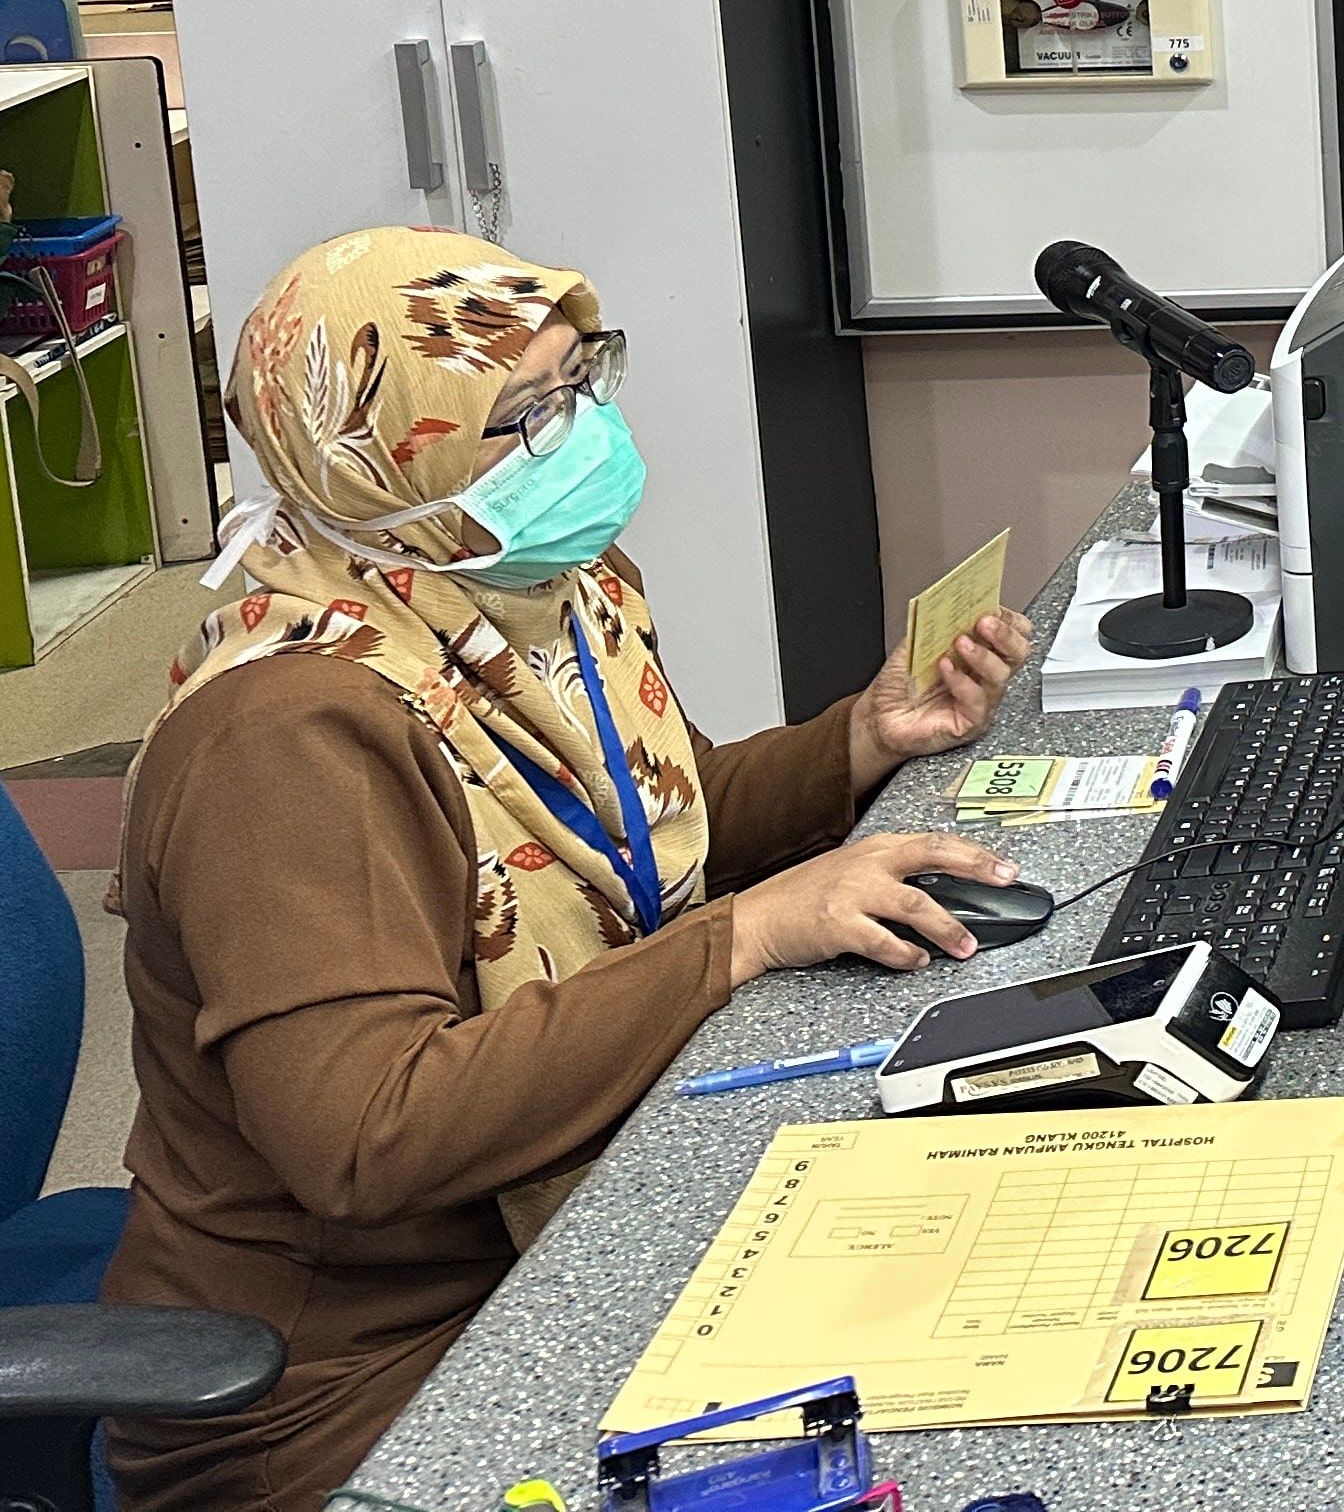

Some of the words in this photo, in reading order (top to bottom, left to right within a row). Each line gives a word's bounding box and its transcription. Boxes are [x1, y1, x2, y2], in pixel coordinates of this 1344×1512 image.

[1169, 39, 1189, 49] 775
[985, 761, 1024, 795] 5308
[1025, 1132, 1077, 1144] KLANG
[1082, 1130, 1126, 1139] 41200
[1072, 1140, 1134, 1150] TENGKU
[1142, 1136, 1215, 1147] HOSPITAL
[926, 1148, 998, 1160] RAHIMAH
[1002, 1144, 1067, 1155] AMPUAN
[794, 1160, 809, 1171] 9
[784, 1179, 800, 1190] 8
[774, 1195, 788, 1205] 7
[763, 1213, 779, 1224] 6
[752, 1231, 768, 1241] 5
[1167, 1232, 1276, 1262] 7206
[742, 1249, 759, 1260] 4
[732, 1267, 748, 1279] 3
[720, 1286, 737, 1297] 2
[710, 1305, 723, 1316] 1
[697, 1324, 713, 1336] 0
[1127, 1345, 1243, 1375] 7206
